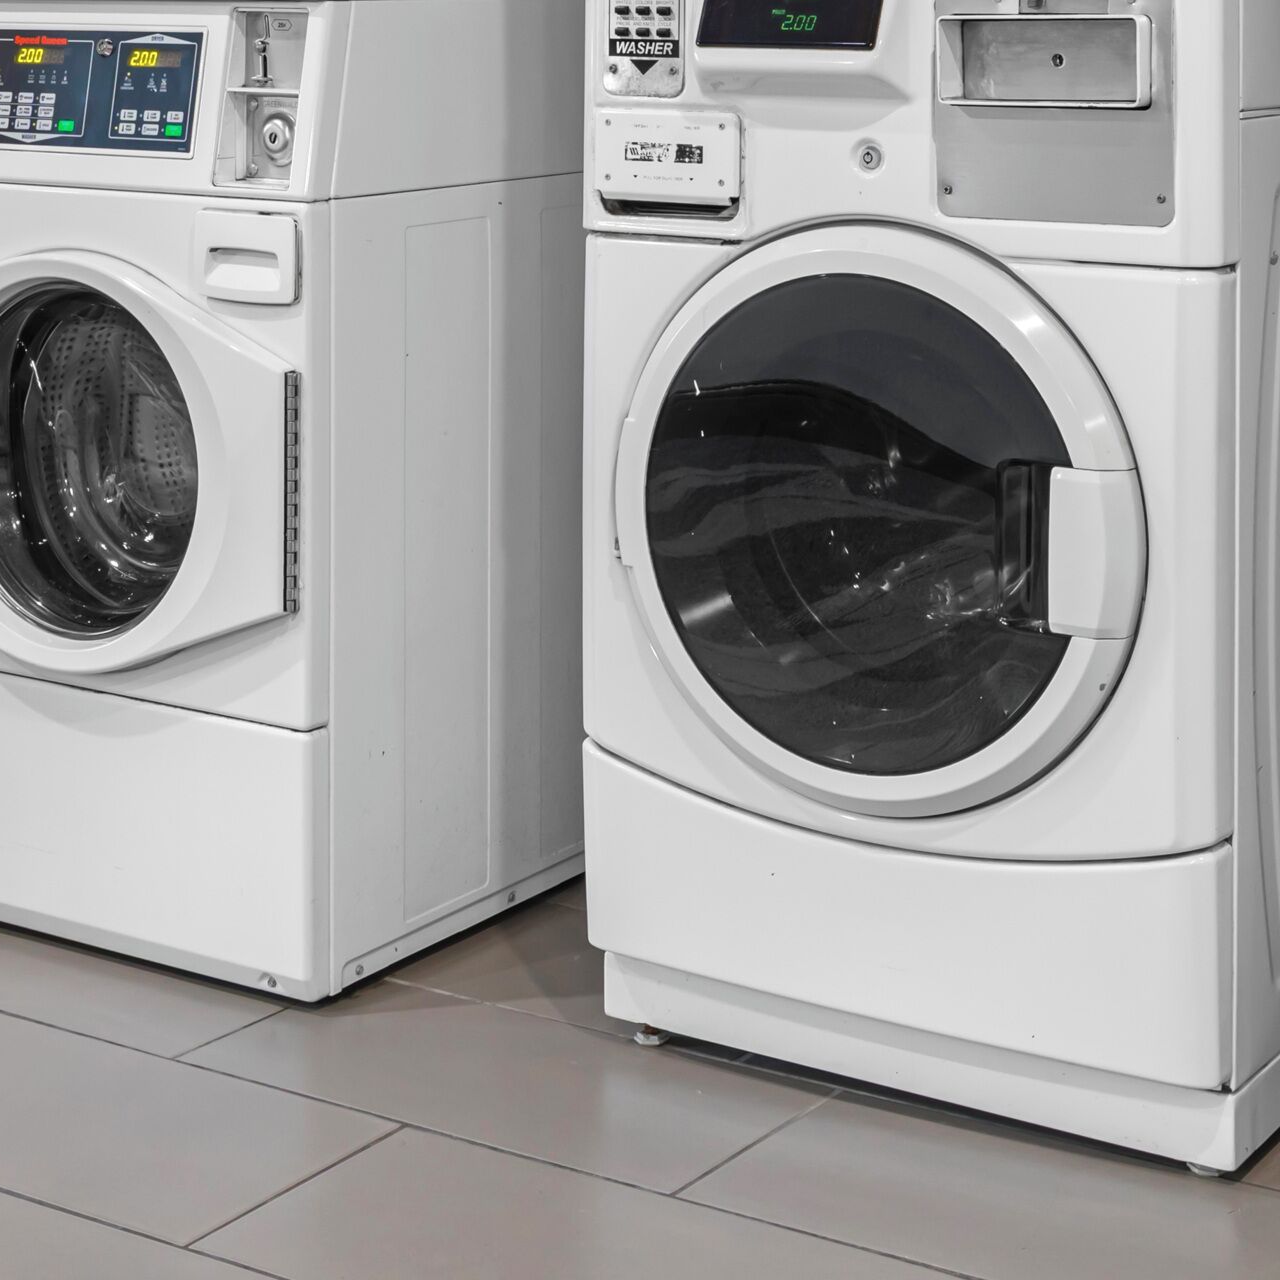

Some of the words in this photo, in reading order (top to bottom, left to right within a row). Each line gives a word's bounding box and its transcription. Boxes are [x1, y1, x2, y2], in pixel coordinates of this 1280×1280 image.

[781, 14, 817, 31] 2.00
[18, 48, 44, 63] 2.00
[616, 41, 673, 55] WASHER
[130, 51, 158, 66] 2.00
